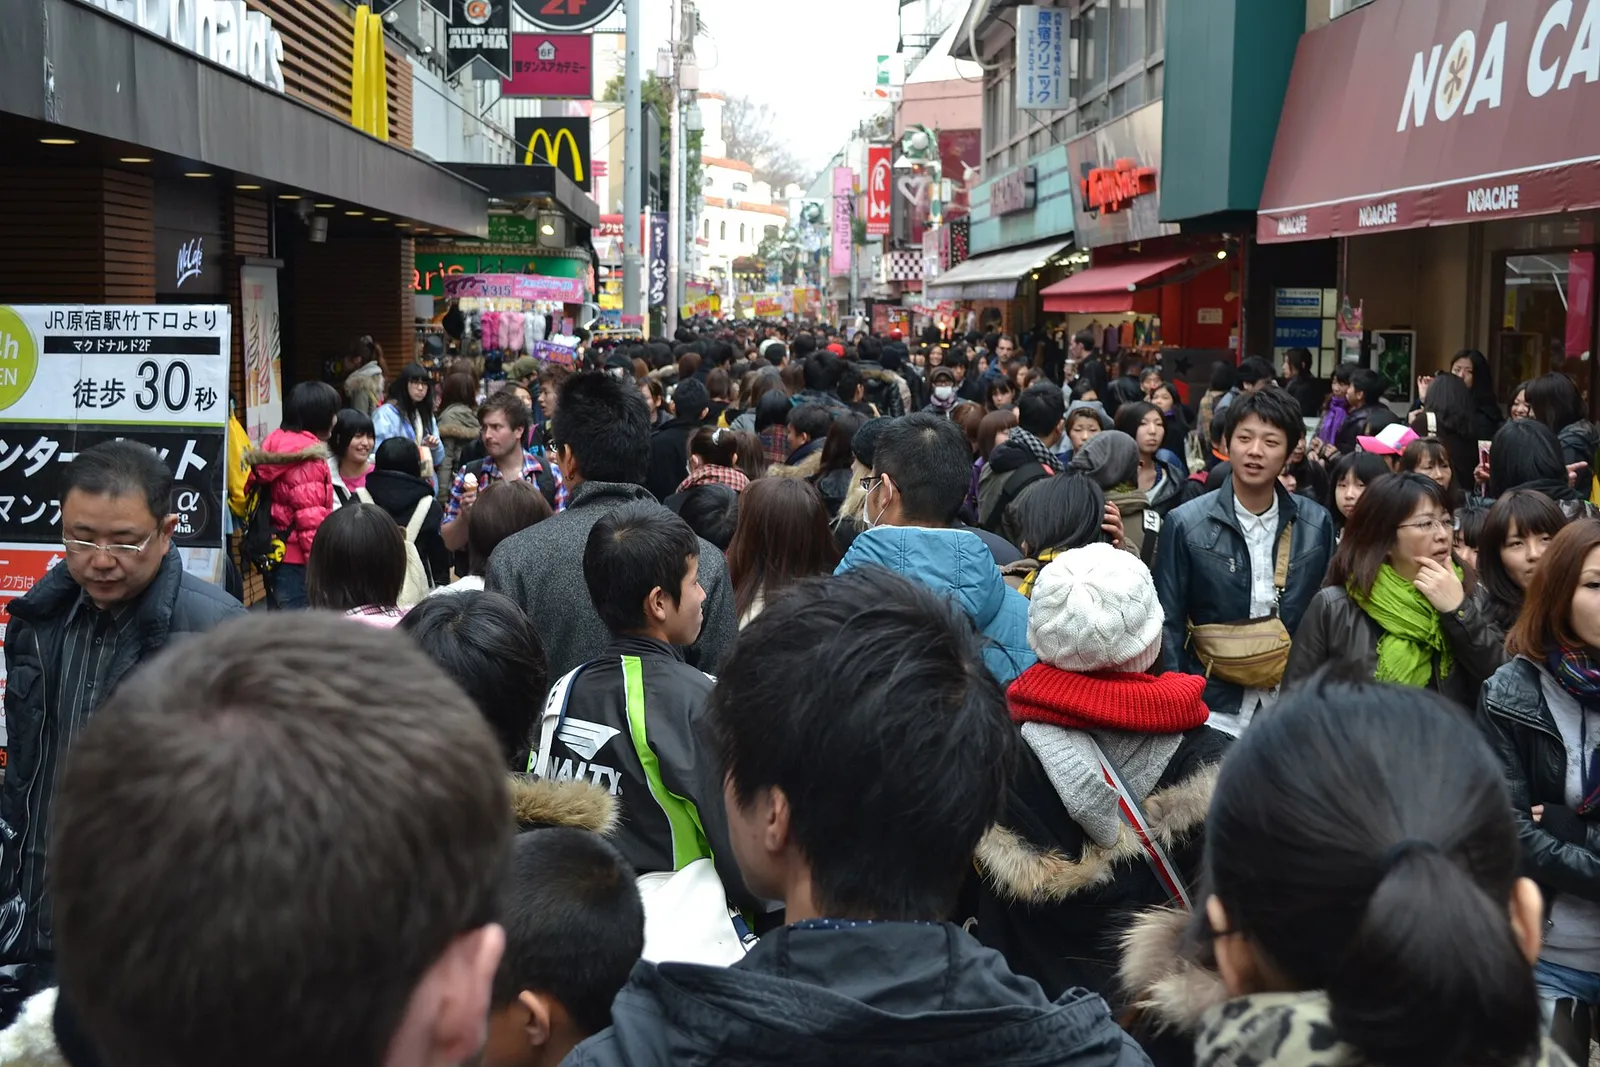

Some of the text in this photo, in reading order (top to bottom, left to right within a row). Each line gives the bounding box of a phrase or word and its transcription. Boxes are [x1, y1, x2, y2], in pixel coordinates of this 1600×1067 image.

[448, 34, 508, 49] ALPHA
[540, 48, 553, 58] 6F
[1396, 21, 1508, 133] NOA
[1466, 184, 1519, 213] NOACAFE
[1358, 202, 1397, 227] NOACAFE
[44, 309, 218, 332] JR原宿駅竹下口より
[73, 338, 151, 353] マクドナルド2F
[527, 749, 622, 795] PNALTY
